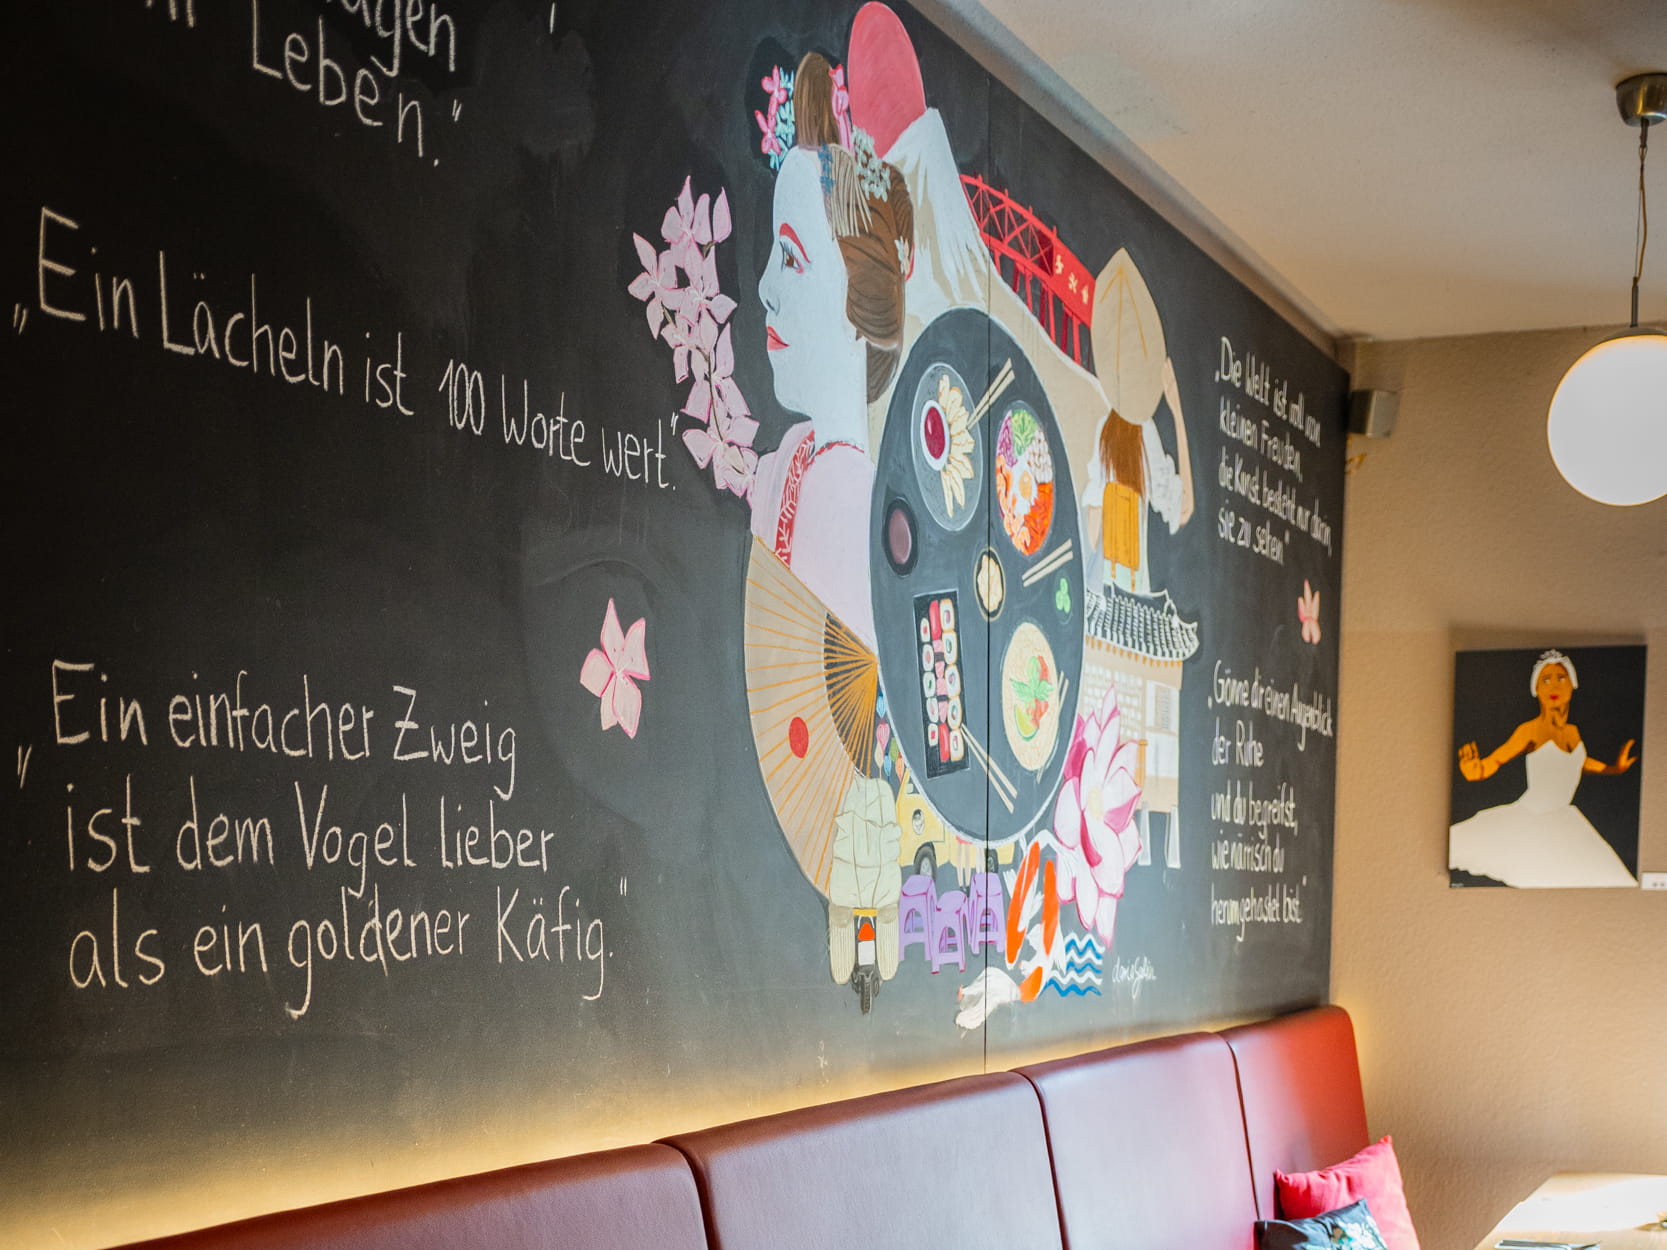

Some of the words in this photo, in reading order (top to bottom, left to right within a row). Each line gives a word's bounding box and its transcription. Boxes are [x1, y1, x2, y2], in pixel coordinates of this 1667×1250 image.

[326, 0, 456, 77] gen
[159, 250, 345, 394] Lächeln
[364, 331, 414, 415] ist
[438, 362, 486, 436] 100
[501, 374, 592, 466] Worte
[1245, 351, 1270, 407] Welt
[1273, 378, 1288, 420] ist
[1219, 394, 1258, 450] kleinen
[1218, 445, 1234, 491] die
[1234, 452, 1261, 506] Kunst
[1262, 469, 1297, 526] besteht
[1236, 516, 1252, 549] zu
[167, 670, 374, 760] einfacher
[393, 685, 517, 800] Zweig
[1211, 716, 1232, 767] der
[1235, 719, 1265, 768] Ruhe
[1250, 665, 1264, 710] dir
[1264, 677, 1290, 722] einen
[1289, 681, 1334, 752] Augenblick
[66, 775, 151, 874] ist
[175, 775, 274, 872] dem
[294, 781, 416, 898] Vogel
[441, 795, 555, 872] lieber
[1210, 779, 1231, 823] und
[1233, 779, 1247, 826] du
[1211, 828, 1230, 871] wie
[1272, 831, 1285, 873] du
[69, 887, 166, 989] als
[193, 904, 269, 976] ein
[285, 883, 470, 1020] goldener
